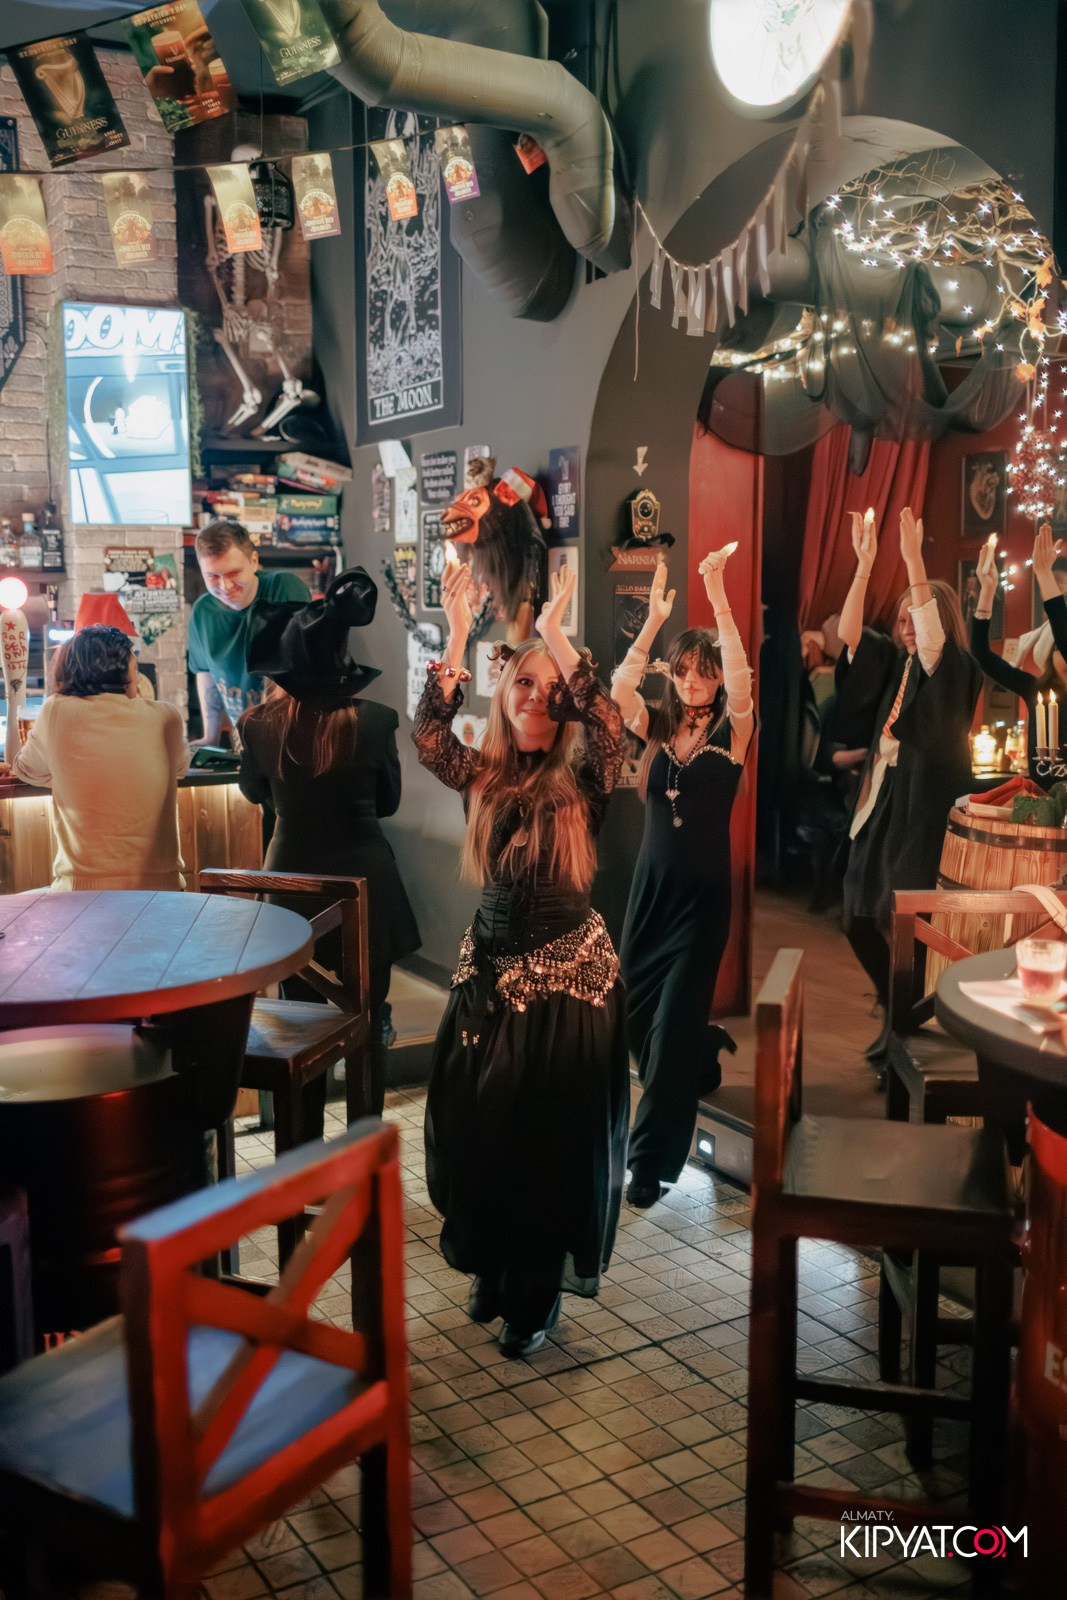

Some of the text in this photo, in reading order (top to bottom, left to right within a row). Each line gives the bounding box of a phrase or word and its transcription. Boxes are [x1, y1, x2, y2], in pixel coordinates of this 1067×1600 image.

[279, 35, 322, 58] GUINNESS
[56, 117, 109, 140] GUINNESS
[374, 395, 395, 418] THE
[617, 552, 656, 565] NARNIA
